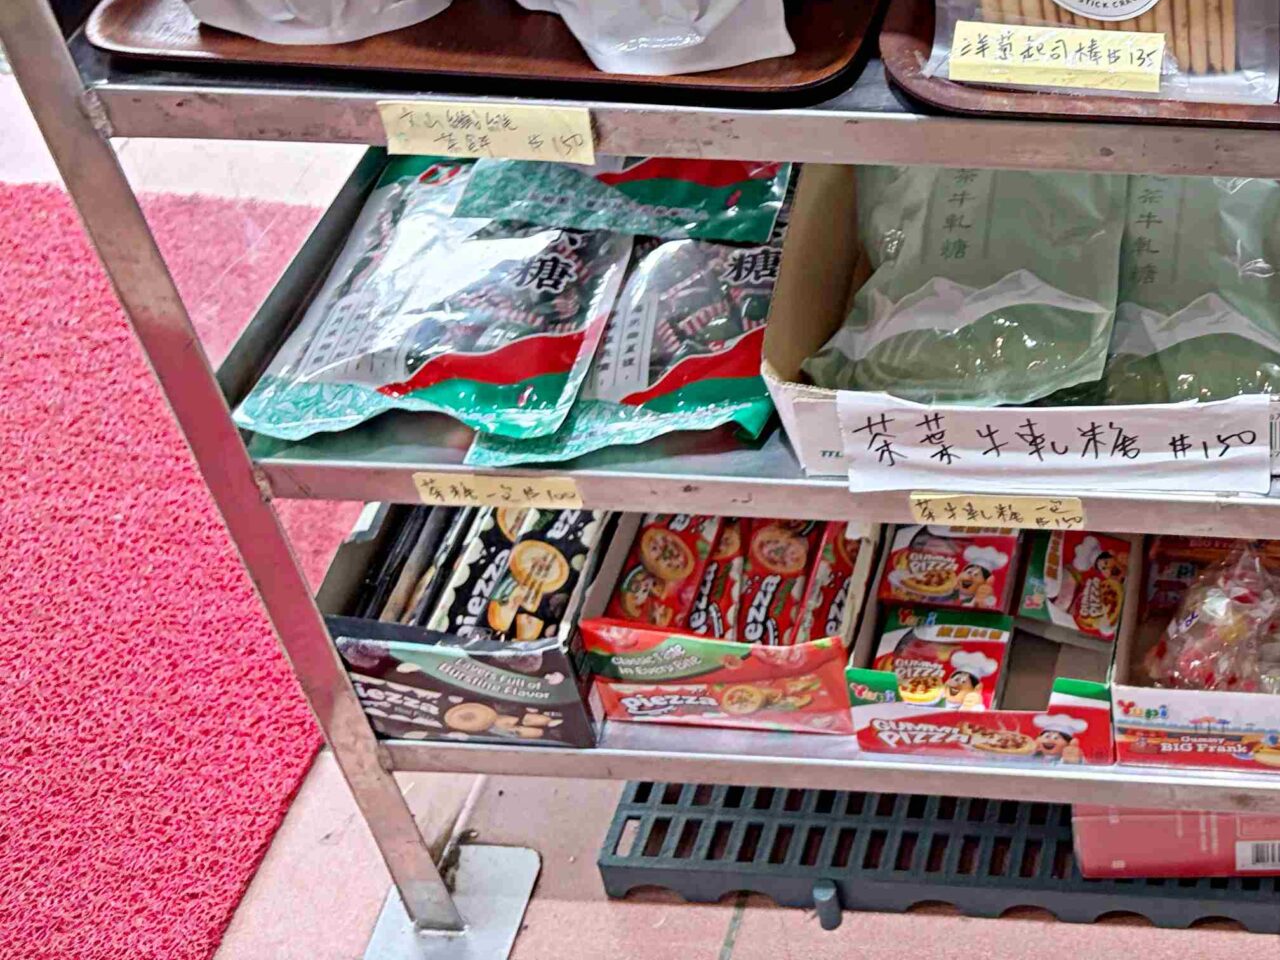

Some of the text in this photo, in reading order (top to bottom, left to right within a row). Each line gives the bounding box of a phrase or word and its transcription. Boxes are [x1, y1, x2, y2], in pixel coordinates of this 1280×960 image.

[854, 413, 1140, 465] 茶葉牛軋糖
[500, 673, 526, 688] Full
[529, 680, 541, 690] of
[504, 685, 550, 700] Flavor
[1161, 742, 1249, 754] BIG Frank
